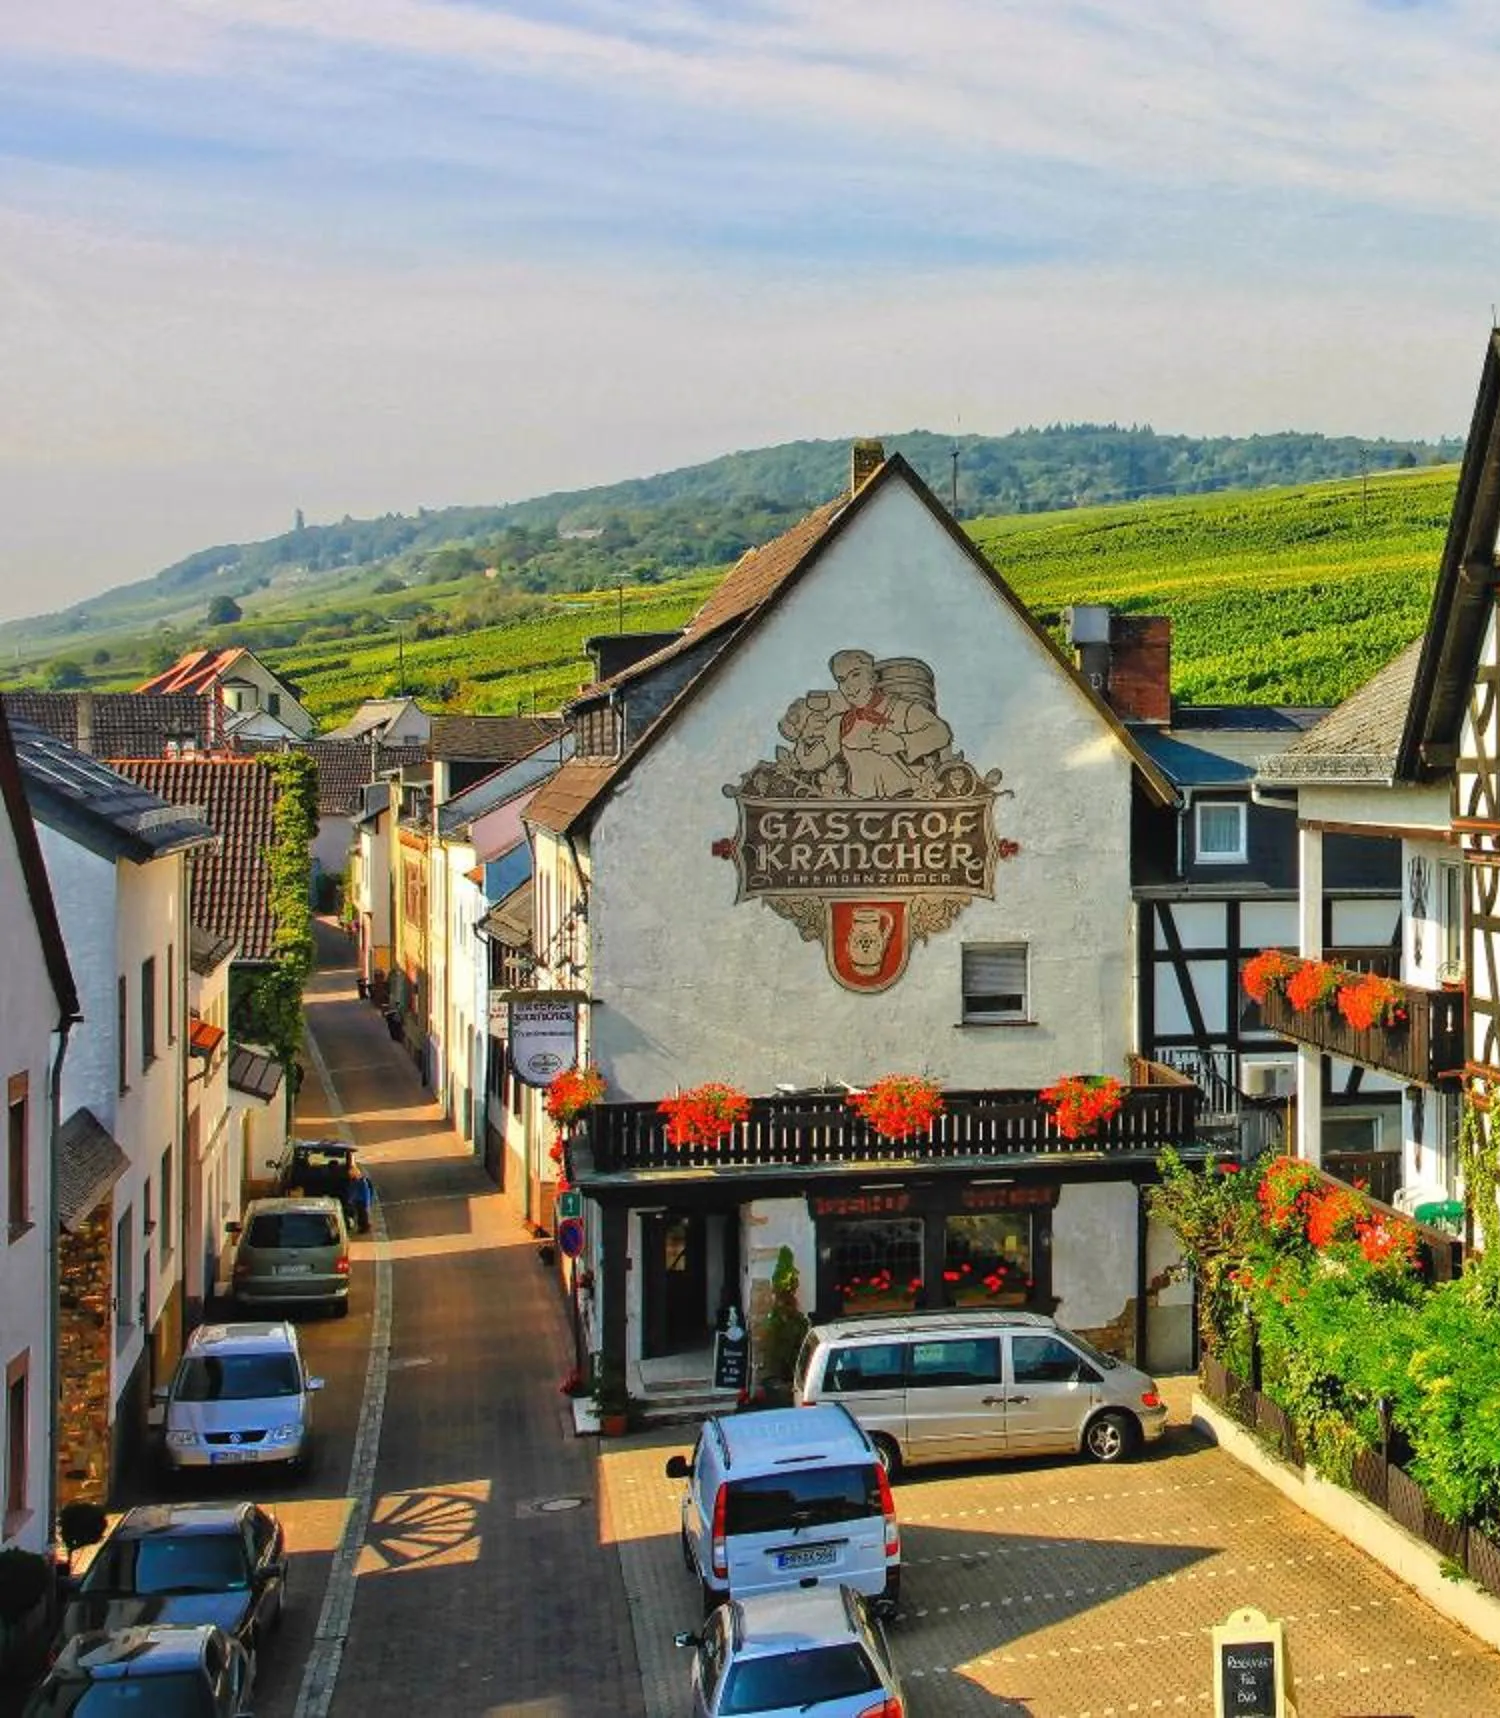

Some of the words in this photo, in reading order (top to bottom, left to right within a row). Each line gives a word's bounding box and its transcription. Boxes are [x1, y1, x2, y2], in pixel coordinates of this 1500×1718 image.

[758, 810, 978, 841] GASTHOF
[754, 842, 984, 876] KRANCHER
[787, 872, 951, 885] FREMDENZIMMER
